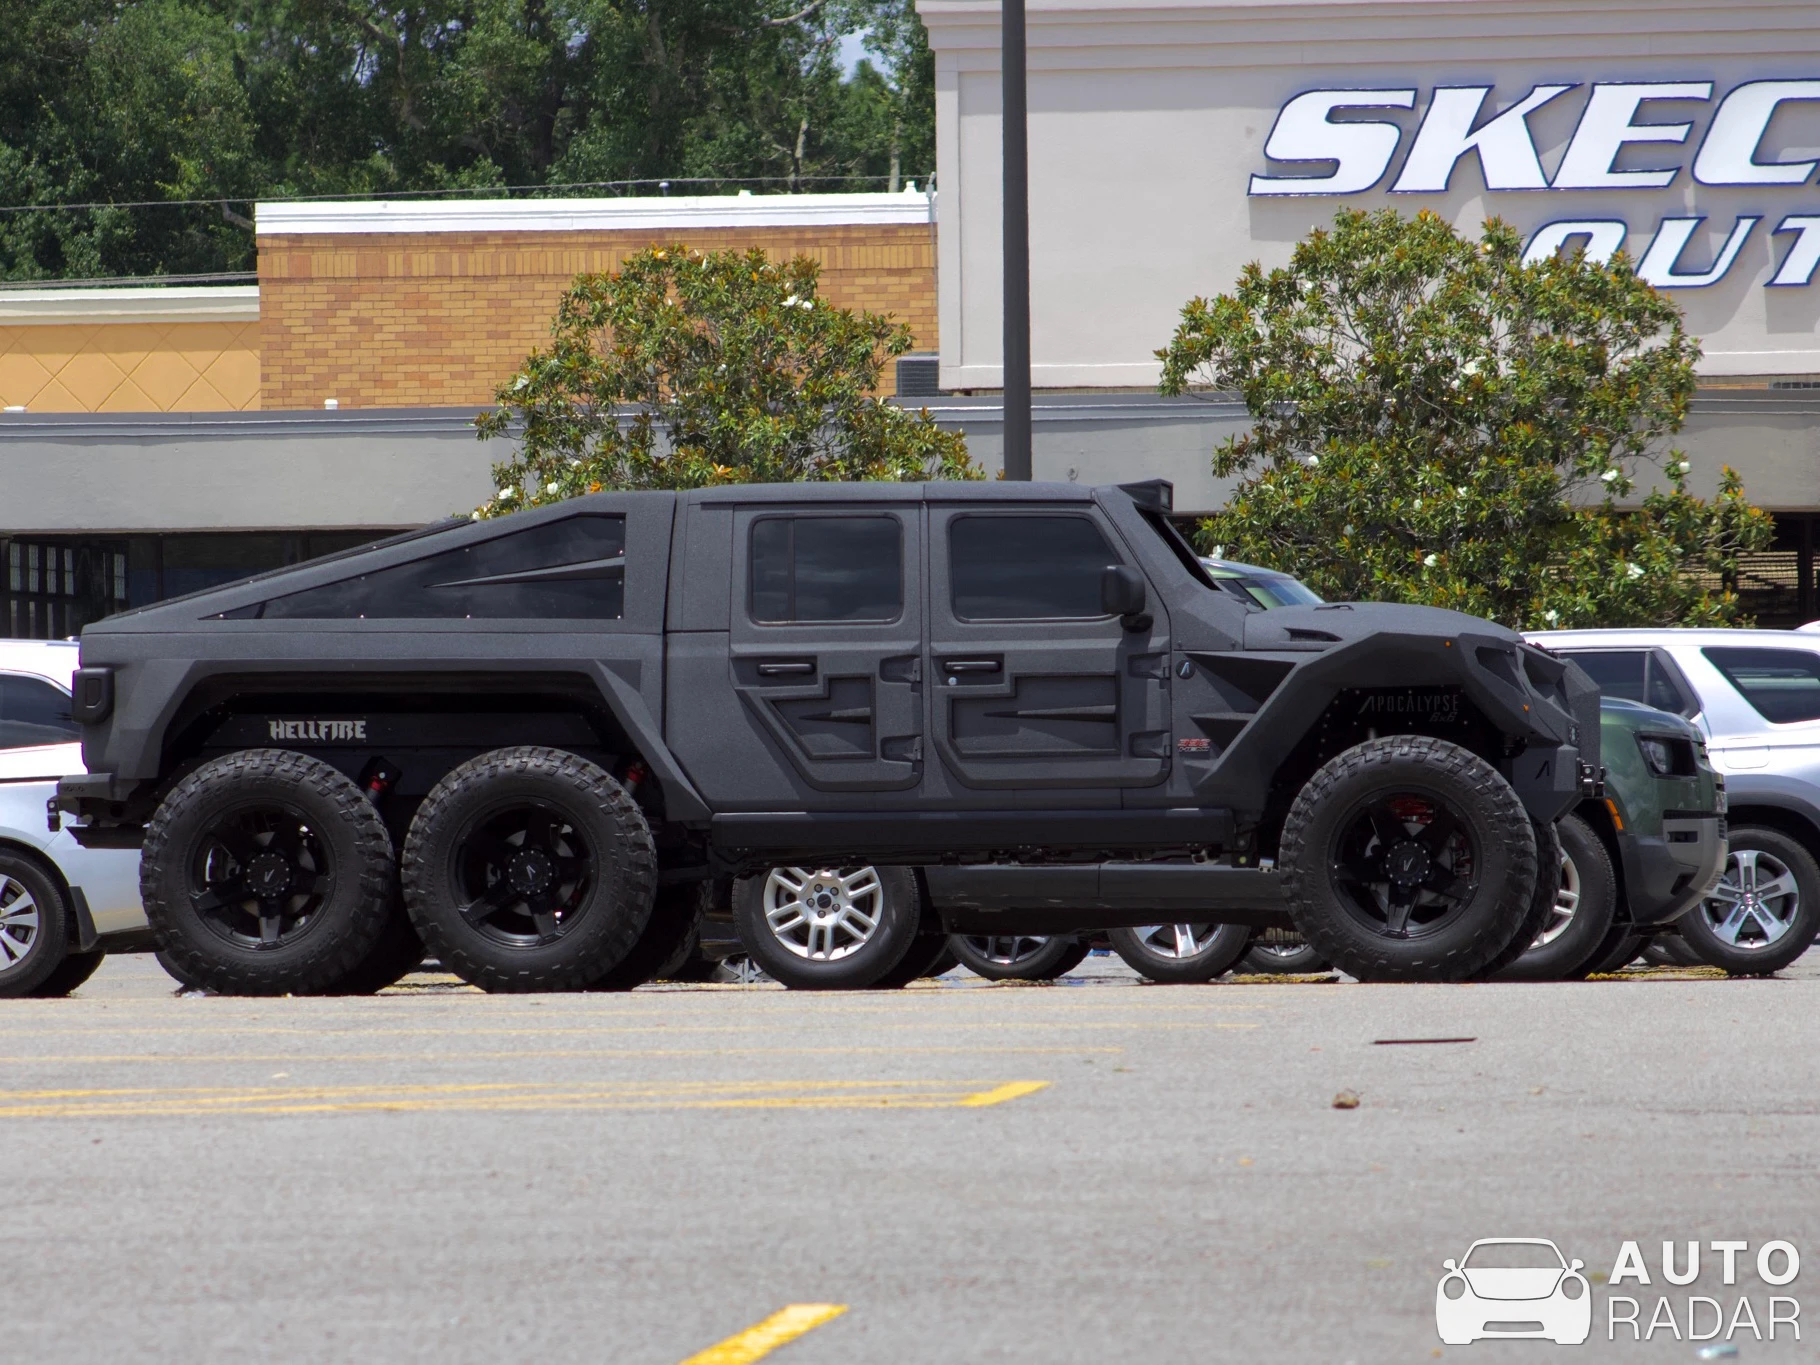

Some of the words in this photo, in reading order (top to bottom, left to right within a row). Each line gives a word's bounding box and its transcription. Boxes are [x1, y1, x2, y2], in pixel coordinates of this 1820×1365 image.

[1247, 78, 1820, 196] SKEC
[1358, 694, 1459, 714] APOCALYPSE
[268, 719, 366, 741] HELLFIRE
